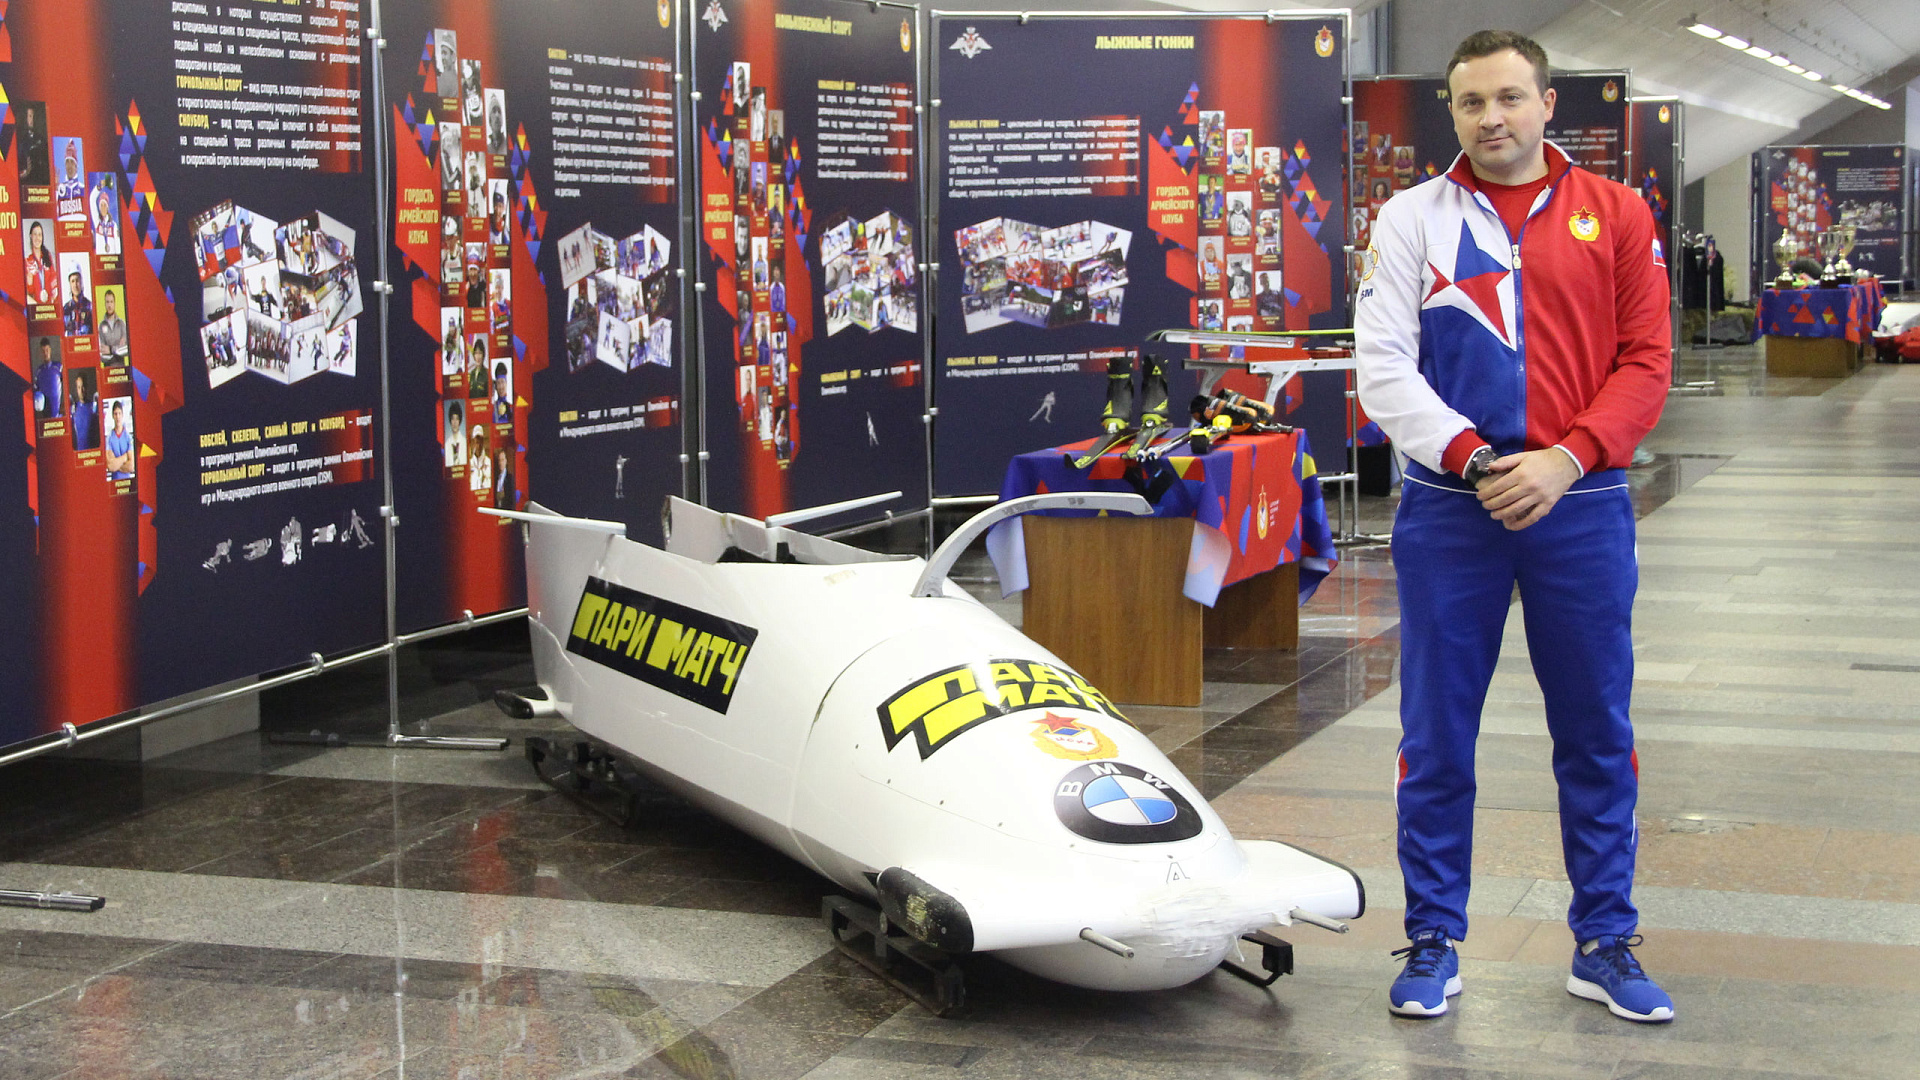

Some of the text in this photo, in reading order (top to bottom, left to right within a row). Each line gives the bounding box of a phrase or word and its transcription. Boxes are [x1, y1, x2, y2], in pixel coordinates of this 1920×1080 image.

[1095, 34, 1194, 50] ЛЫЖНЫЕ ГОНКИ
[404, 188, 434, 204] ГОРДОСТЬ
[1156, 186, 1190, 198] ГОРДОСТЬ
[1150, 198, 1195, 211] АРМЕЙСКОГО
[398, 206, 438, 224] АРМЕЙСКОГО
[1162, 214, 1184, 224] КЛУБА
[408, 230, 428, 244] КЛУБА
[572, 592, 748, 695] ПАРИ МАТЧ
[922, 682, 1106, 746] МАТ
[1057, 763, 1172, 797] BMW
